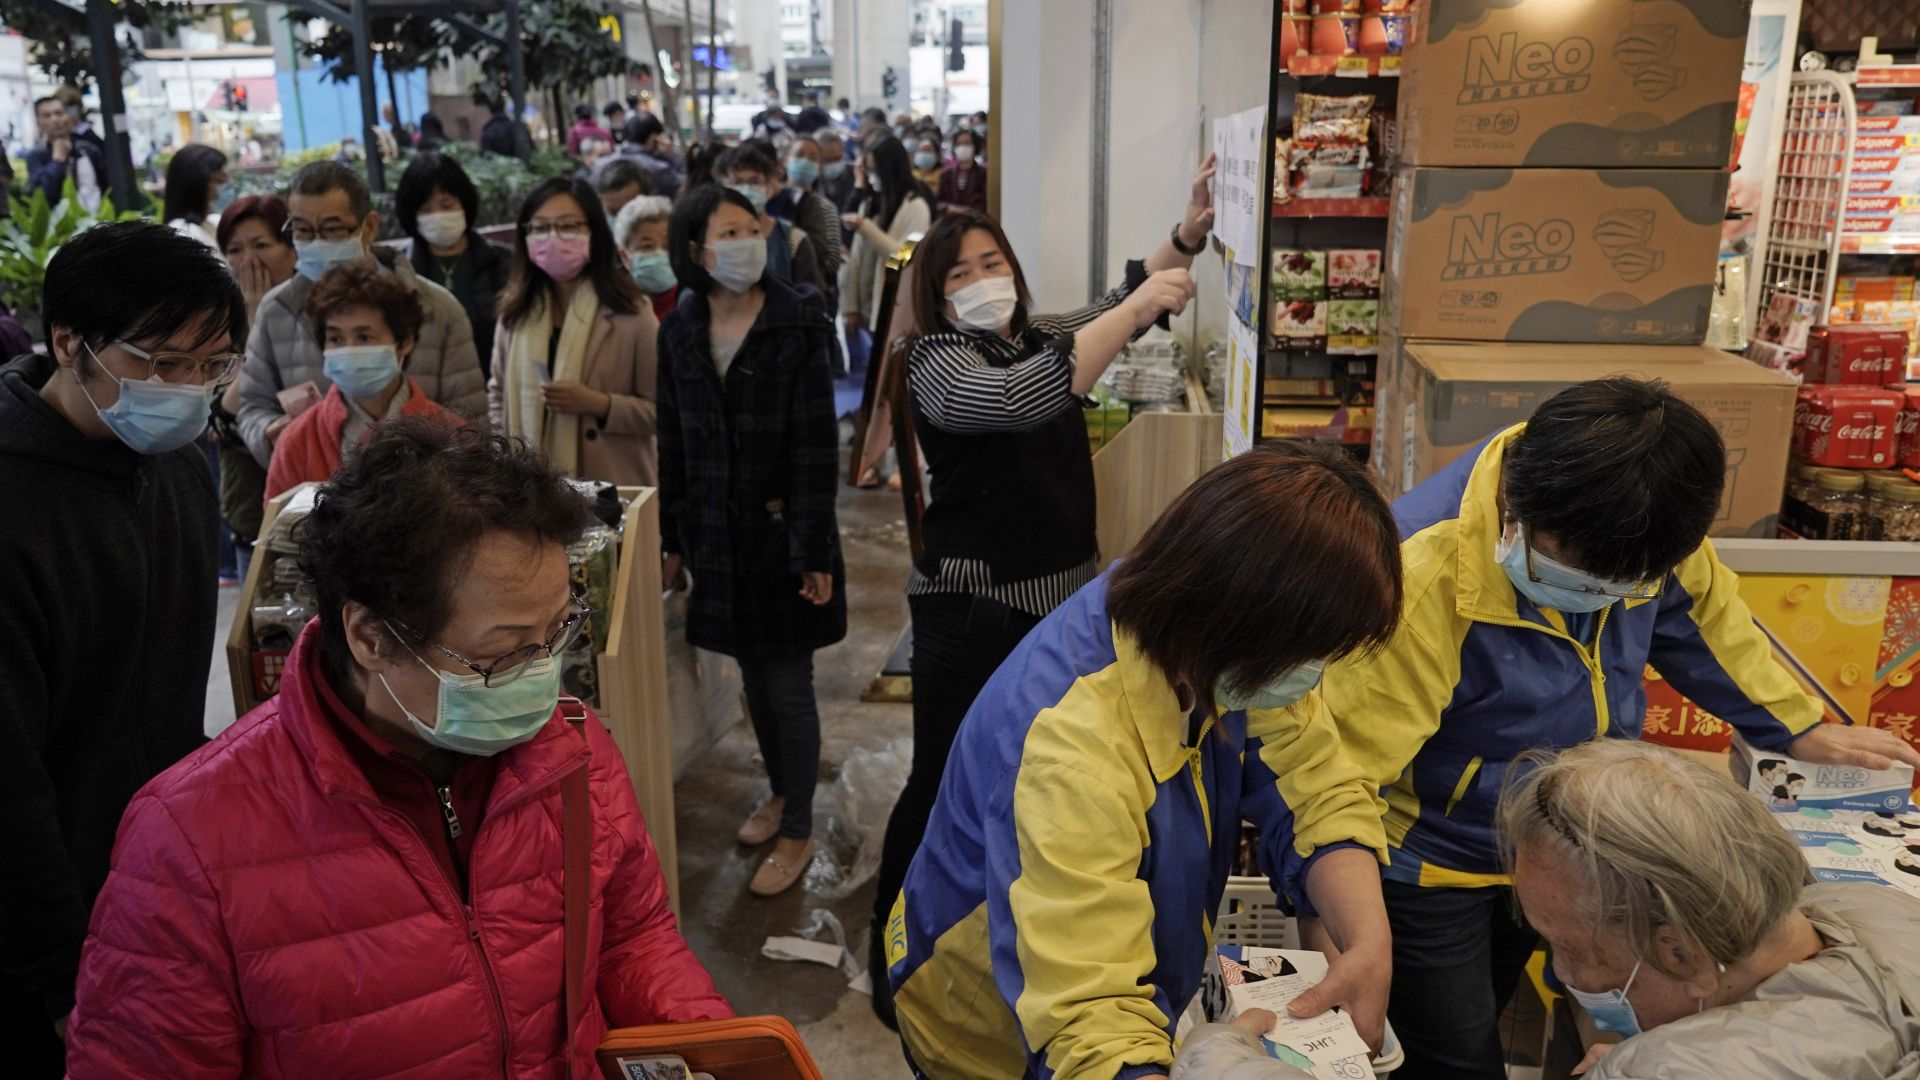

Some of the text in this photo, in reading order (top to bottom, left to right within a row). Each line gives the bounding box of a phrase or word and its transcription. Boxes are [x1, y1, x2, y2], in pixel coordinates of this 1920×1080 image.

[1463, 31, 1595, 86] Neo
[1470, 79, 1577, 102] MASKER
[1448, 212, 1574, 265] Neo
[1455, 258, 1559, 279] MASKER
[1643, 704, 1733, 737] 家」添
[1816, 765, 1871, 785] Neo
